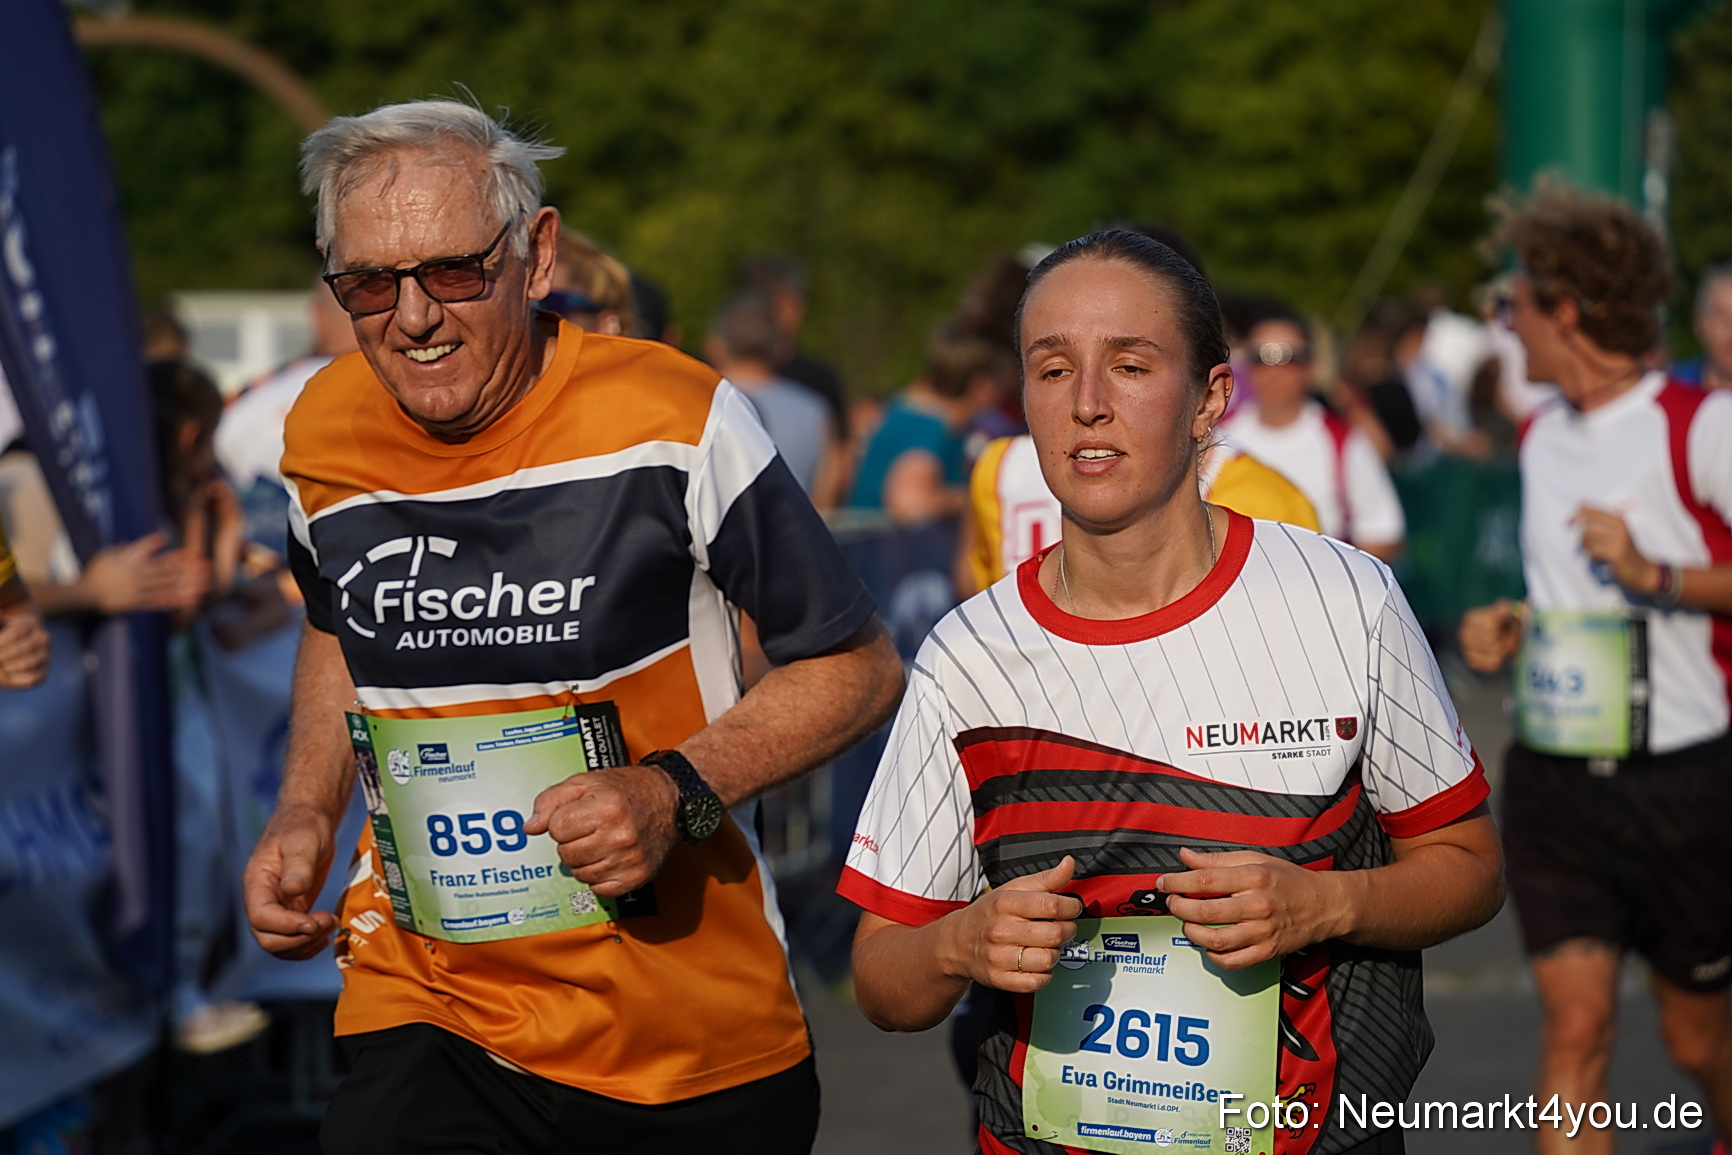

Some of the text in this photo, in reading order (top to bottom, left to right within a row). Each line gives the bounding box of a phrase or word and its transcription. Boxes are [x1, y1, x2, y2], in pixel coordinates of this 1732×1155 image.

[373, 564, 596, 624] Fischer
[395, 620, 581, 651] AUTOMOBILE
[579, 716, 600, 769] RABATT
[1186, 718, 1329, 749] NEUMARKT
[1271, 748, 1332, 760] STARKE STADT
[413, 760, 475, 777] Firmenlauf
[438, 772, 477, 783] neumarkt
[426, 809, 529, 858] 859
[430, 863, 553, 888] Franz Fischer
[1094, 951, 1168, 966] Firmenlauf
[1122, 965, 1165, 975] neumarkt
[1079, 1004, 1211, 1067] 2615
[1061, 1065, 1098, 1088] Eva
[1107, 1096, 1125, 1106] Stadt
[1125, 1099, 1157, 1110] Neumarkt
[1080, 1125, 1152, 1141] firmenlauf.bayern
[1173, 1137, 1212, 1145] Firmenlauf
